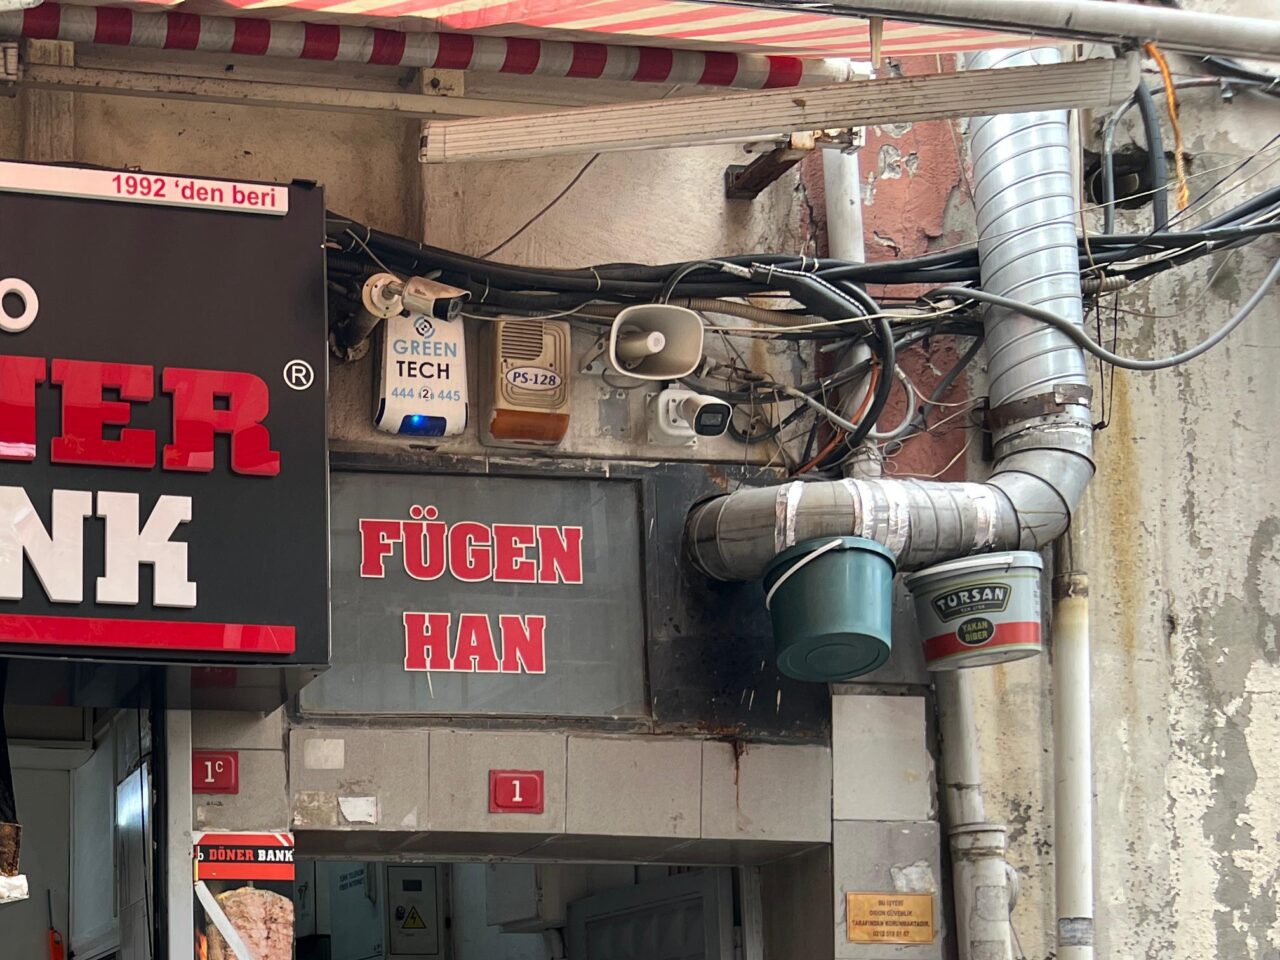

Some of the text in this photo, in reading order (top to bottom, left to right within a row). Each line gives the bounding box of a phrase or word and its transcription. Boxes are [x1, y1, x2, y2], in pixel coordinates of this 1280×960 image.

[112, 174, 166, 198] 1992
[232, 185, 276, 208] beri
[392, 339, 458, 358] GREEN
[396, 360, 450, 380] TECH
[512, 372, 557, 387] PS-128
[392, 387, 414, 399] 444
[437, 390, 461, 401] 445
[359, 504, 583, 584] FÜGEN
[403, 611, 546, 674] HAN
[512, 780, 523, 802] 1
[209, 846, 254, 861] DÖNER
[257, 849, 294, 862] BANK
